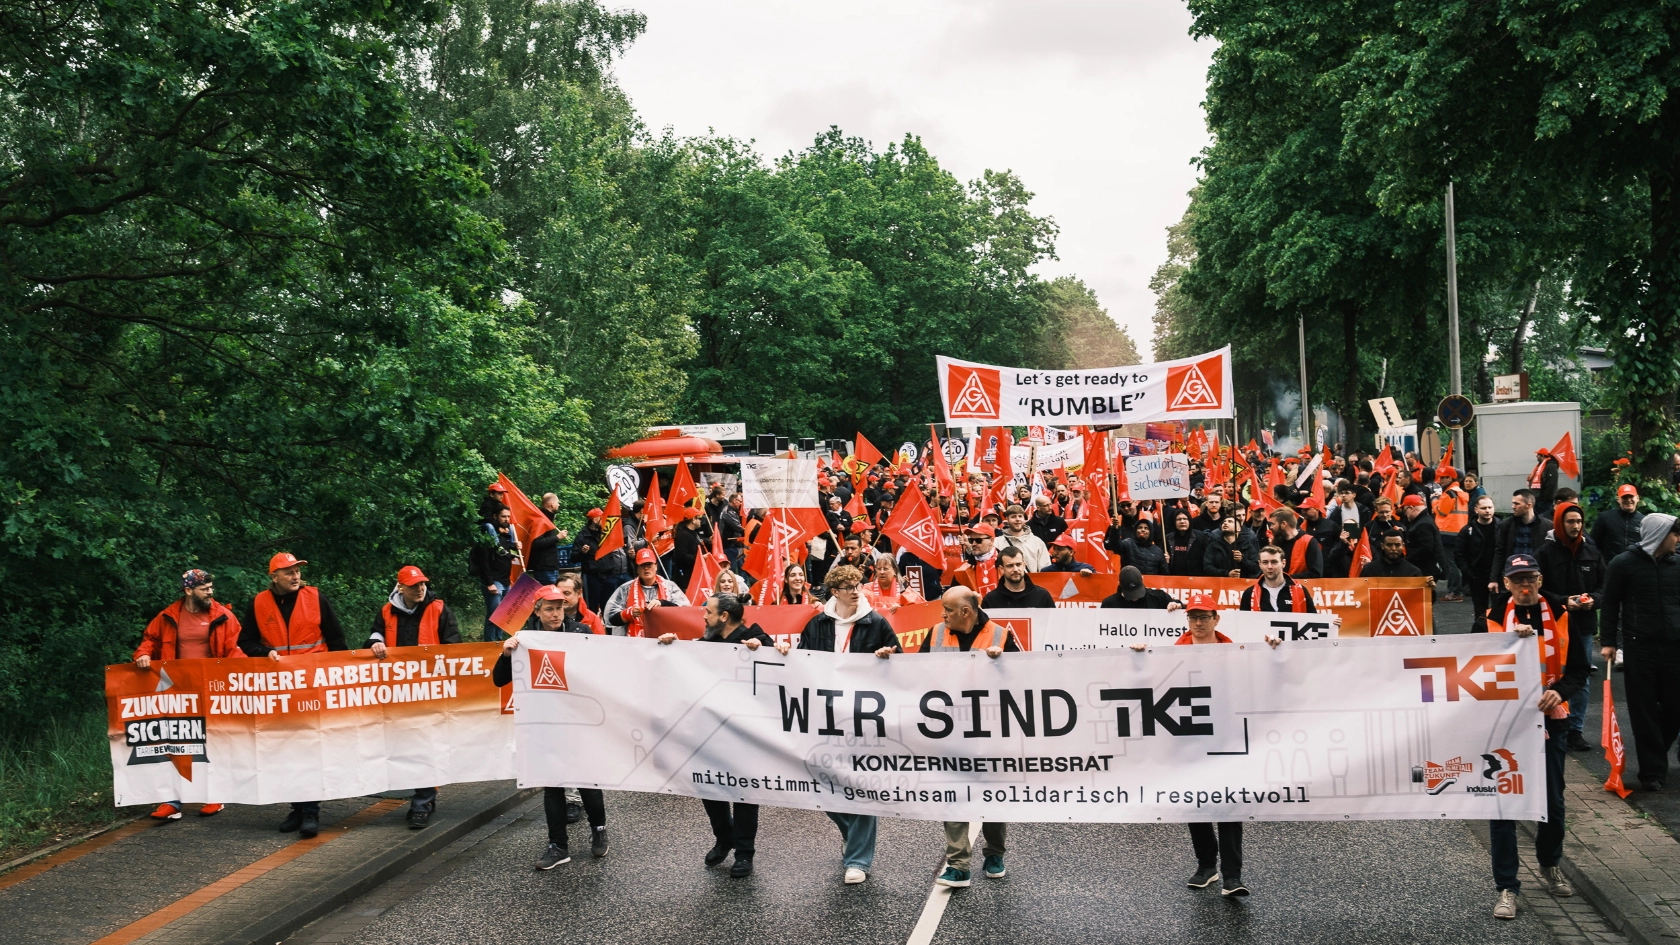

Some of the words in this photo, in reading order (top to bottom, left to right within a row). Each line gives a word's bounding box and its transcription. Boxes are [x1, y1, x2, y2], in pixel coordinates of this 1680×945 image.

[1055, 374, 1080, 388] get
[1084, 372, 1128, 387] ready
[1133, 372, 1148, 383] to
[1099, 623, 1138, 637] Hallo
[1144, 623, 1188, 637] Invest
[208, 679, 226, 693] FÜR
[228, 669, 308, 692] SICHERE
[312, 654, 491, 689] ARBEITSPLÄTZE,
[1403, 653, 1520, 703] TKE
[121, 693, 199, 719] ZUKUNFT
[209, 693, 292, 715] ZUKUNFT
[297, 699, 321, 713] UND
[326, 680, 457, 710] EINKOMMEN
[778, 684, 887, 738] WIR
[916, 688, 1077, 739] SIND
[1100, 686, 1215, 738] TKE
[127, 719, 206, 743] SICHERN.
[852, 754, 1114, 773] KONZERNBETRIEBSRAT
[692, 769, 821, 794] mitbestimmt
[843, 785, 957, 803] gemeinsam
[982, 785, 1129, 804] solidarisch
[1156, 786, 1311, 808] respektvoll
